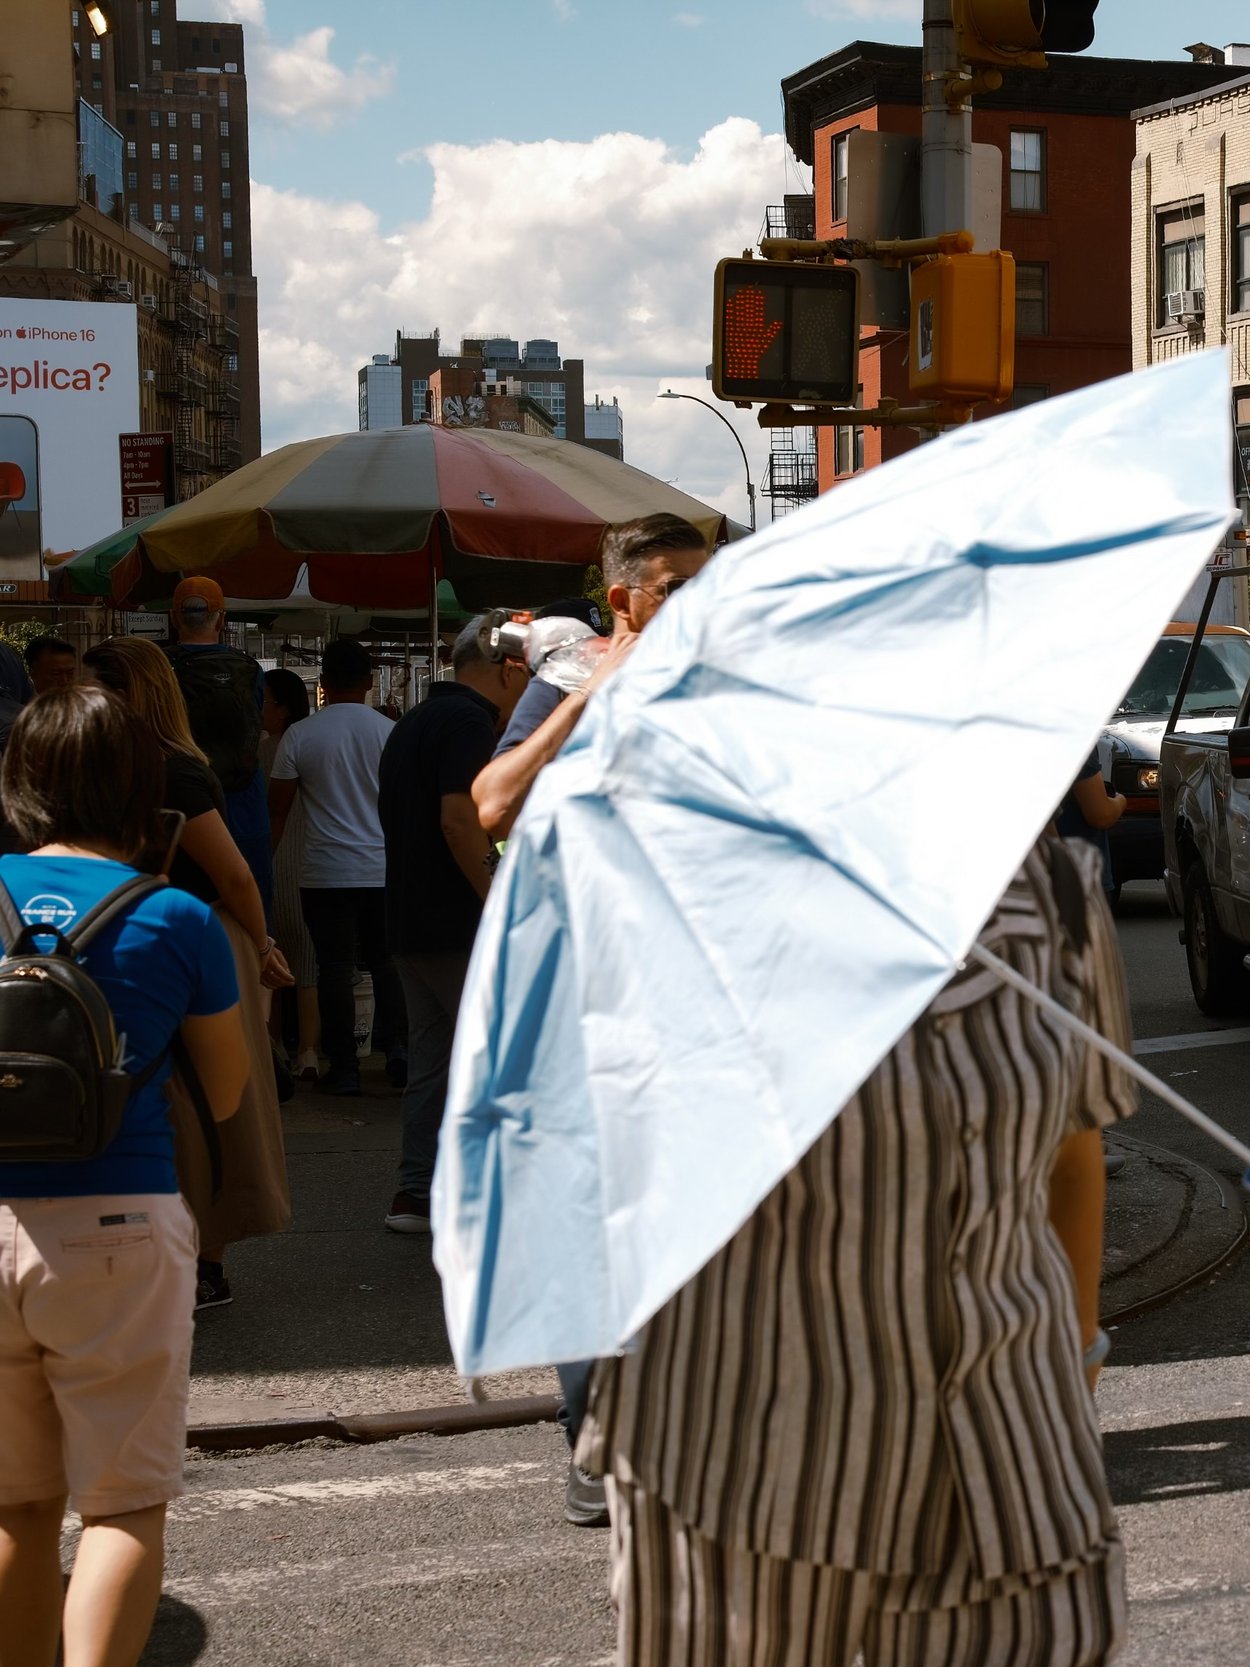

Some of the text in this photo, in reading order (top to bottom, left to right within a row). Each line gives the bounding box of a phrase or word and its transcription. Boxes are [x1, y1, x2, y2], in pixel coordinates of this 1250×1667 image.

[28, 327, 77, 341] iPhone
[79, 329, 96, 341] 16
[122, 437, 164, 447] NO STANDING
[127, 498, 135, 515] 3
